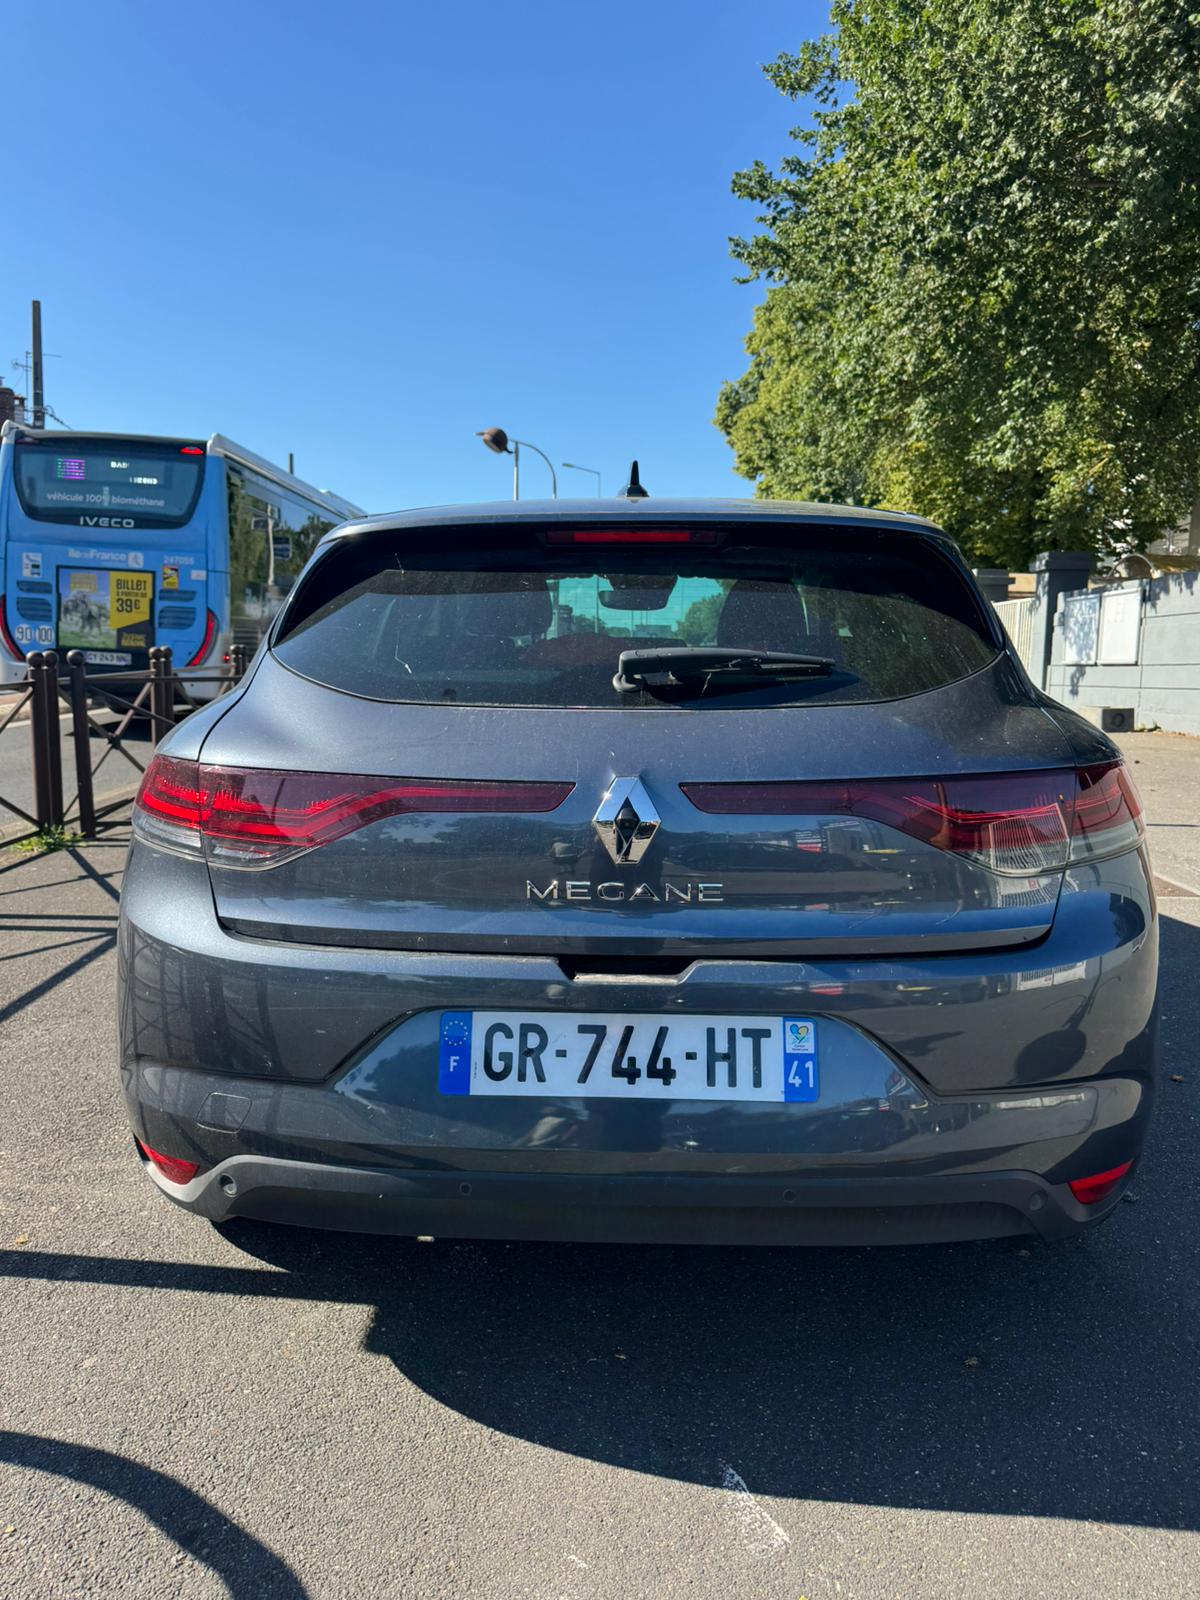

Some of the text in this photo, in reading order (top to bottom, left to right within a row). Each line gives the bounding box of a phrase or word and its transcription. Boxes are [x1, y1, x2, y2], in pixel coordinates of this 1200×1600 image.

[111, 495, 165, 507] biométhane
[80, 516, 134, 528] IVECO
[16, 626, 33, 642] 90
[38, 626, 53, 643] 100
[526, 880, 724, 902] MEGANE
[449, 1055, 460, 1072] F
[483, 1022, 773, 1089] GR-744-HT
[787, 1060, 815, 1089] 41
